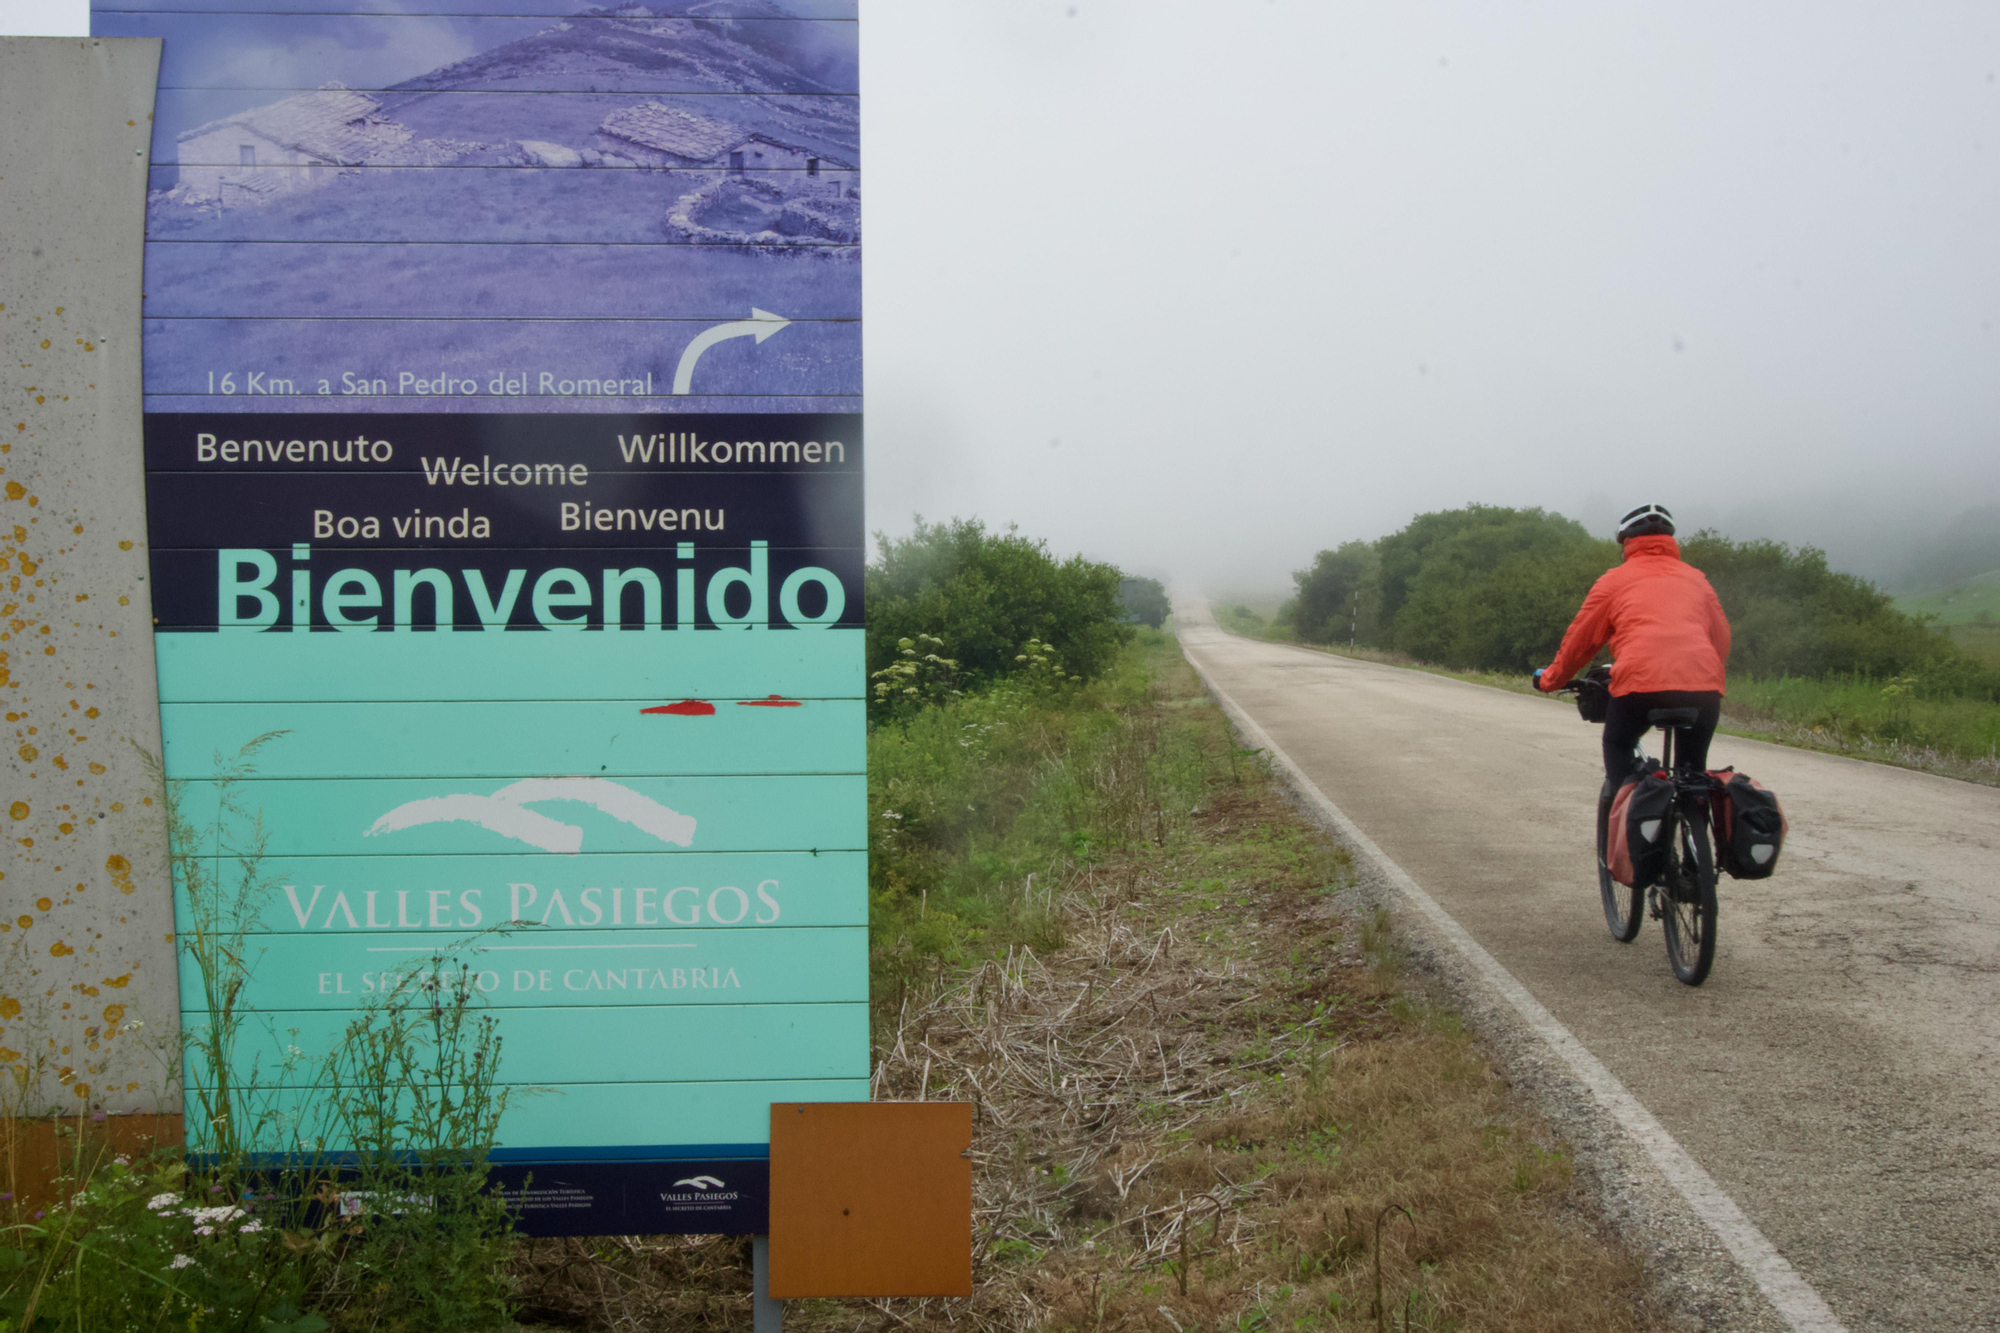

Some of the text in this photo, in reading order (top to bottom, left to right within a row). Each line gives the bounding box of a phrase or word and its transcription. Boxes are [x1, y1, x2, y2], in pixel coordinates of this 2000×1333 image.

[208, 371, 652, 396] 16 Km. a San Pedro del Romeral
[197, 433, 393, 462] Benvenuto
[617, 433, 845, 463] Willkommen
[421, 455, 588, 485] Welcome
[314, 507, 490, 538] Boa vinda
[561, 501, 724, 531] Bienvenu
[218, 540, 846, 632] Bienvenido
[283, 879, 780, 929] VALLES PASIEGOS
[318, 973, 350, 994] EL
[513, 969, 552, 991] DE
[563, 967, 741, 991] CANTABRIA
[660, 1191, 739, 1201] VALLES PASIEGOS
